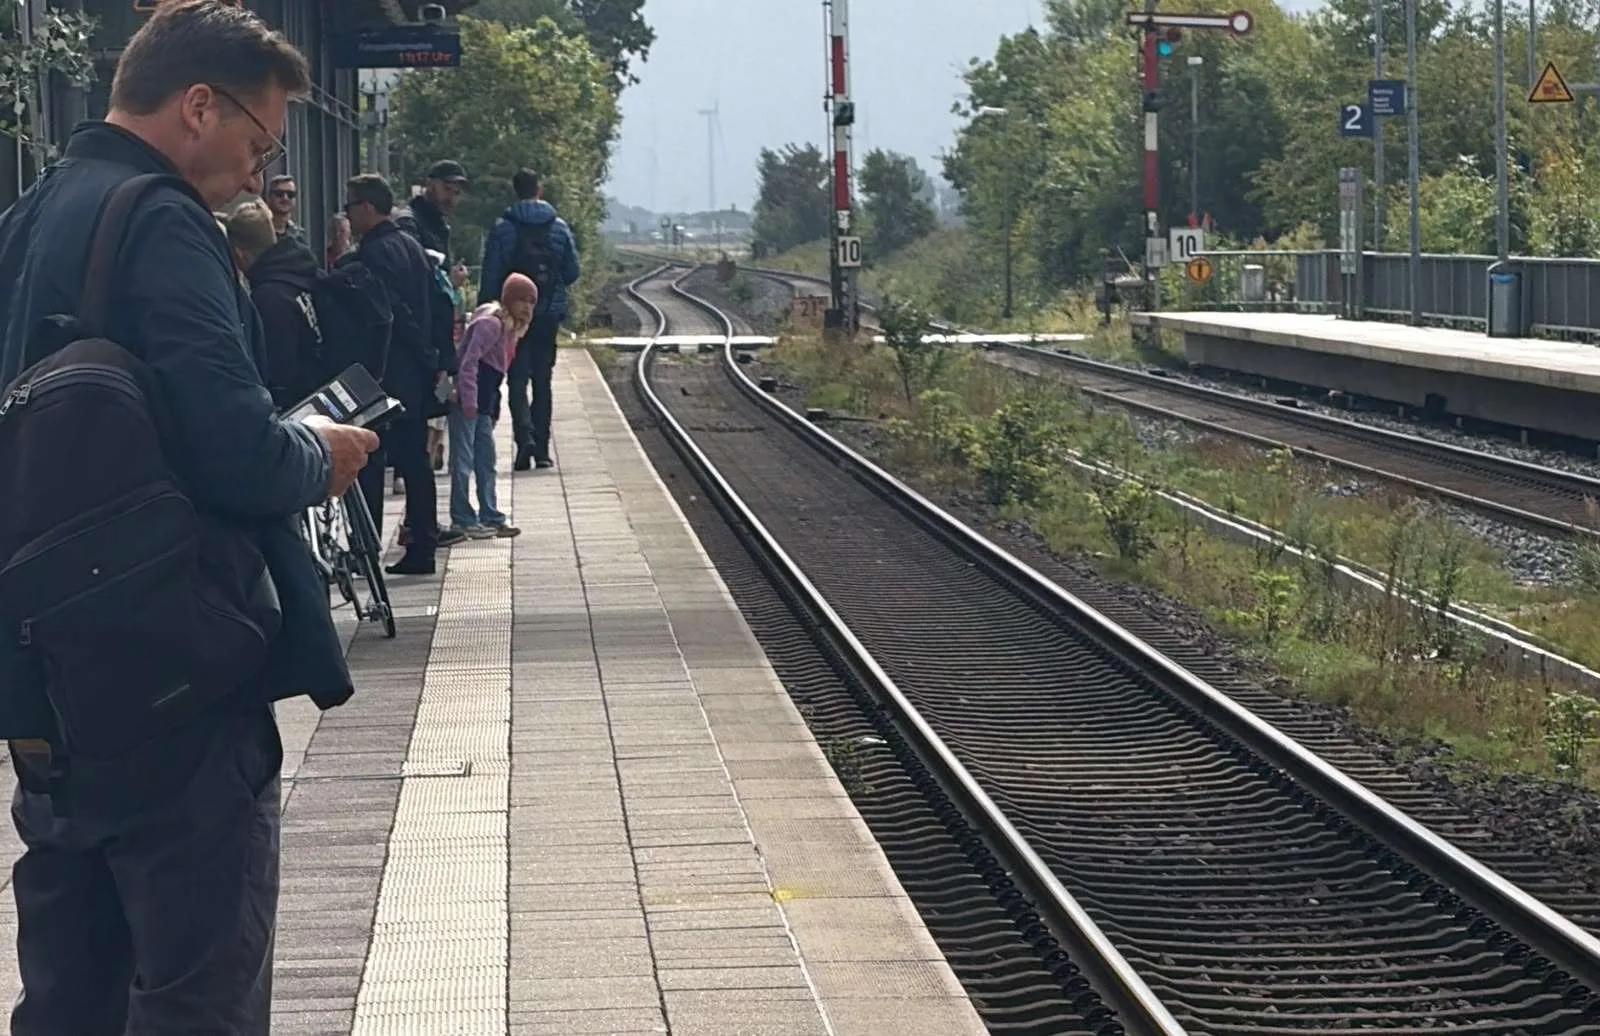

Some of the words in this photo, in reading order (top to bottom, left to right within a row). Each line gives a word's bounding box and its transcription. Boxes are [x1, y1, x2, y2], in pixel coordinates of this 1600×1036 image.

[1345, 105, 1361, 130] 2
[841, 240, 860, 262] 10
[1177, 235, 1197, 258] 10
